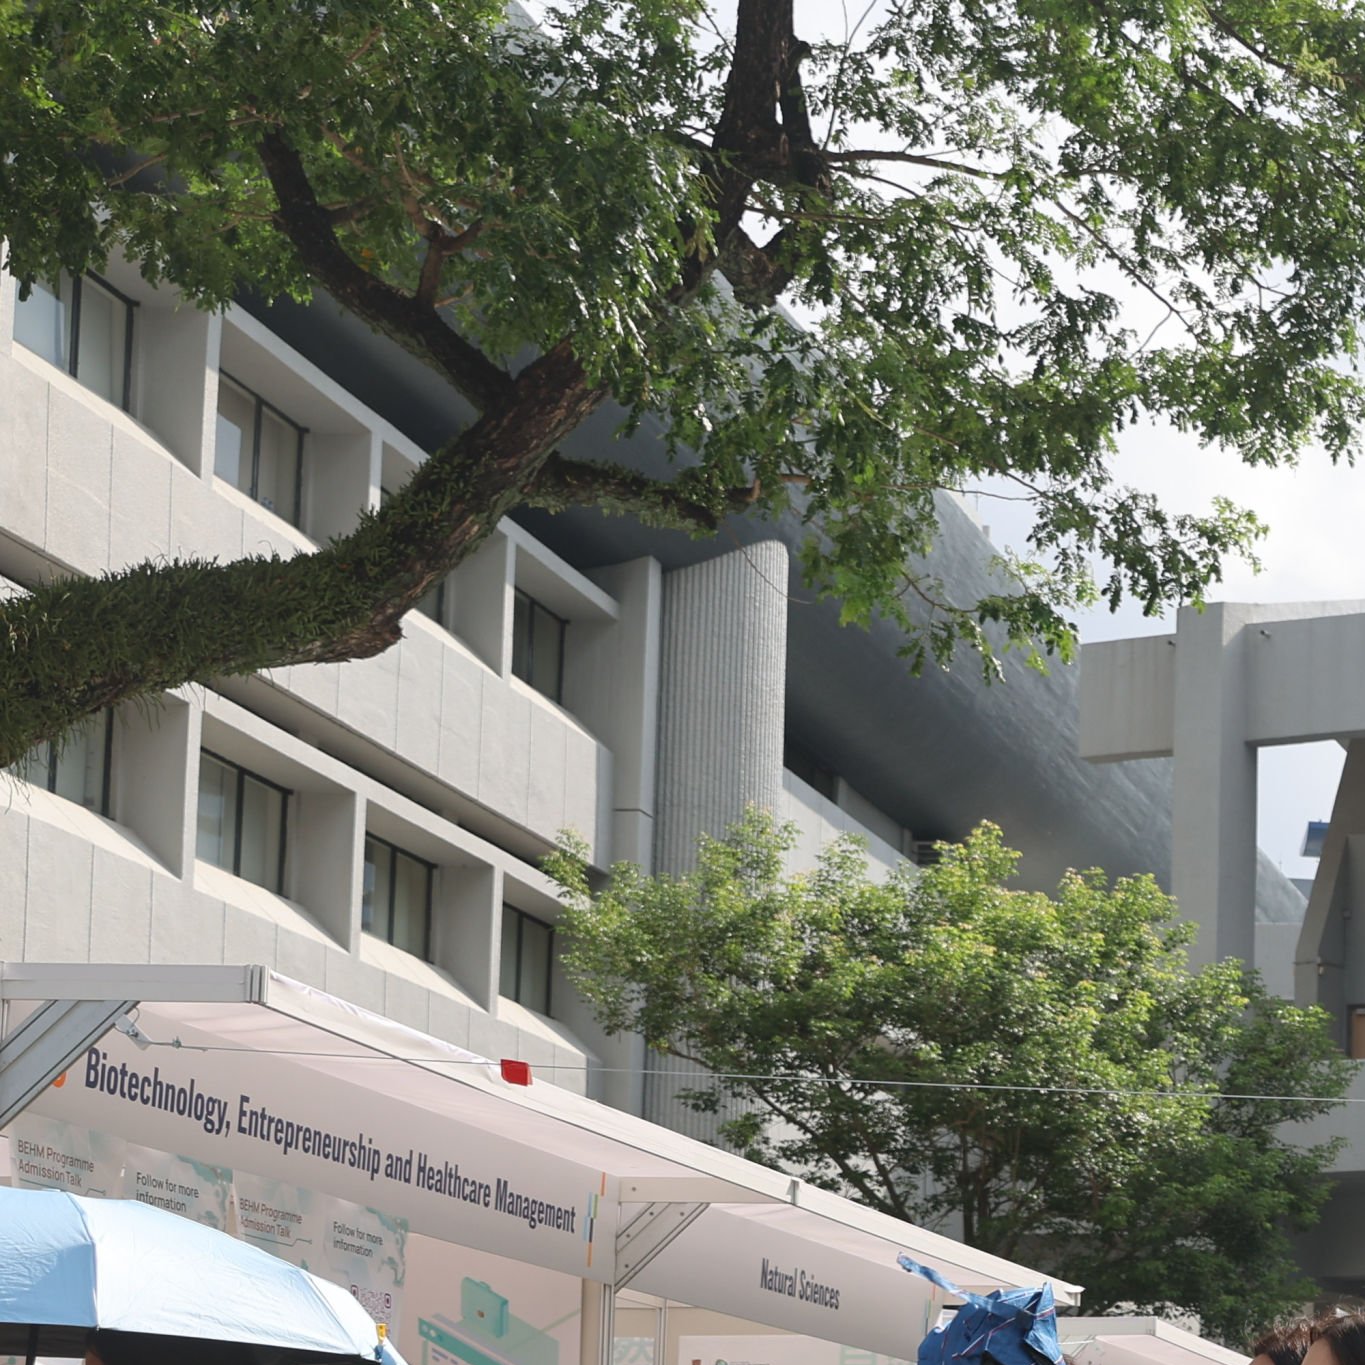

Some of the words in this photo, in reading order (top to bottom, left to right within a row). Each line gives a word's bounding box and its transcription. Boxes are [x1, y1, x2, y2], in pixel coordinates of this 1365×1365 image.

[85, 1047, 231, 1138] Biotechnology,
[237, 1094, 381, 1181] Entrepreneurship
[385, 1150, 412, 1184] and
[417, 1152, 491, 1208] Healthcare
[495, 1177, 576, 1233] Management
[18, 1138, 45, 1161] BEHM
[47, 1147, 94, 1173] Programme
[19, 1161, 65, 1184] Admission
[66, 1171, 82, 1188] Talk
[136, 1172, 164, 1192] Follow
[165, 1178, 177, 1195] for
[178, 1185, 199, 1199] more
[261, 1202, 302, 1224] Programme
[276, 1223, 290, 1238] Talk
[333, 1221, 355, 1237] Follow
[356, 1226, 366, 1240] for
[366, 1232, 383, 1246] more
[333, 1238, 373, 1258] information
[761, 1258, 798, 1298] Natural
[799, 1270, 840, 1311] Sciences
